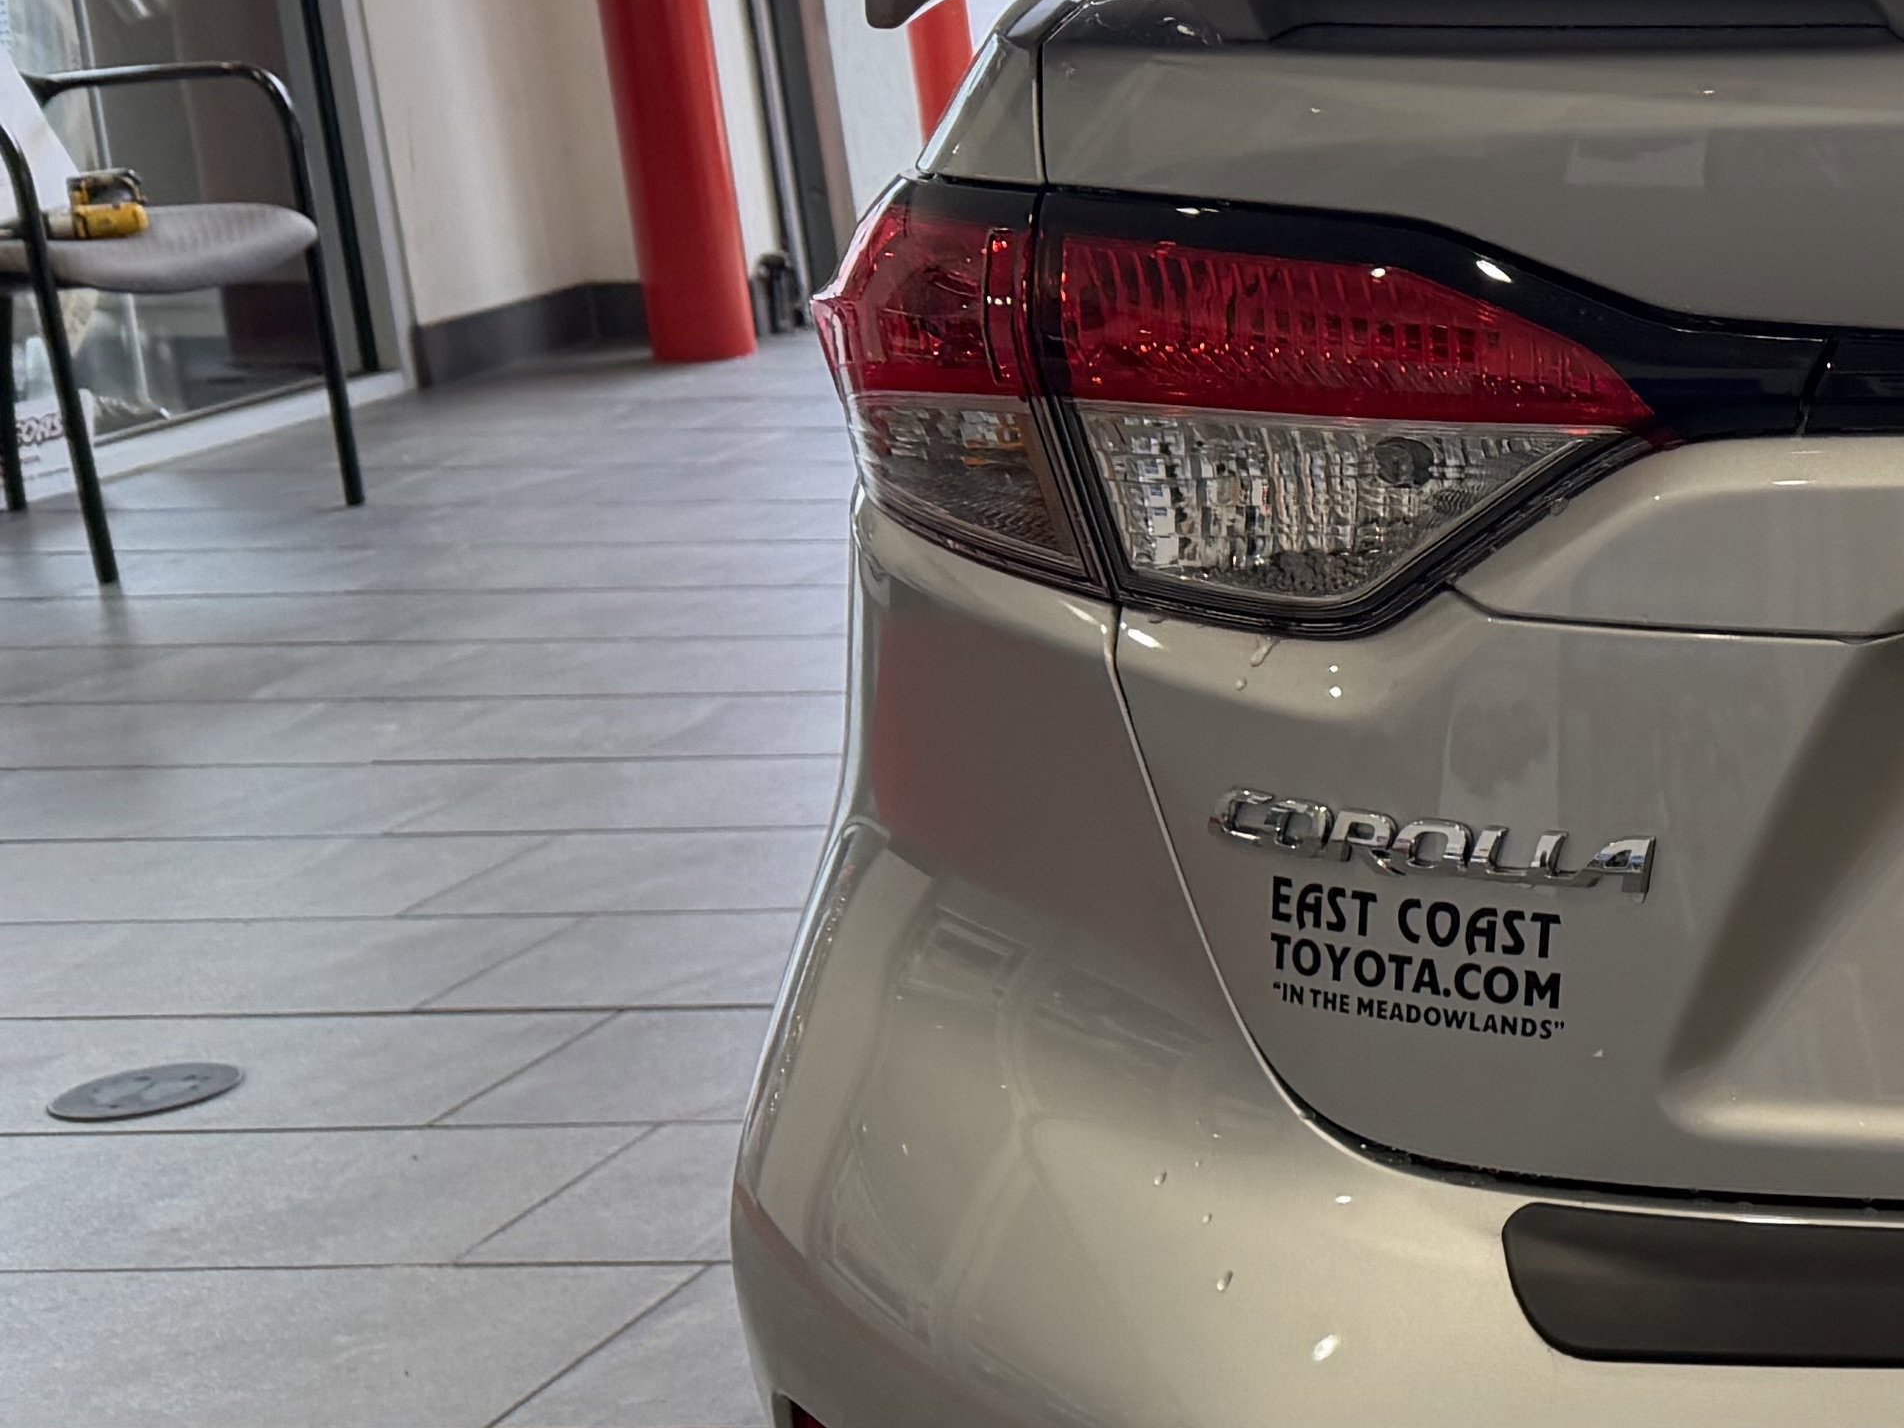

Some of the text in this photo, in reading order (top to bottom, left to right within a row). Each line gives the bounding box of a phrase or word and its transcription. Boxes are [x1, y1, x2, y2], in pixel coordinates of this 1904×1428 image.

[1207, 785, 1657, 903] COROLLA
[1271, 875, 1562, 959] EAST COAST
[1270, 932, 1562, 1010] TOYOTA.COM
[1309, 987, 1350, 1015] THE
